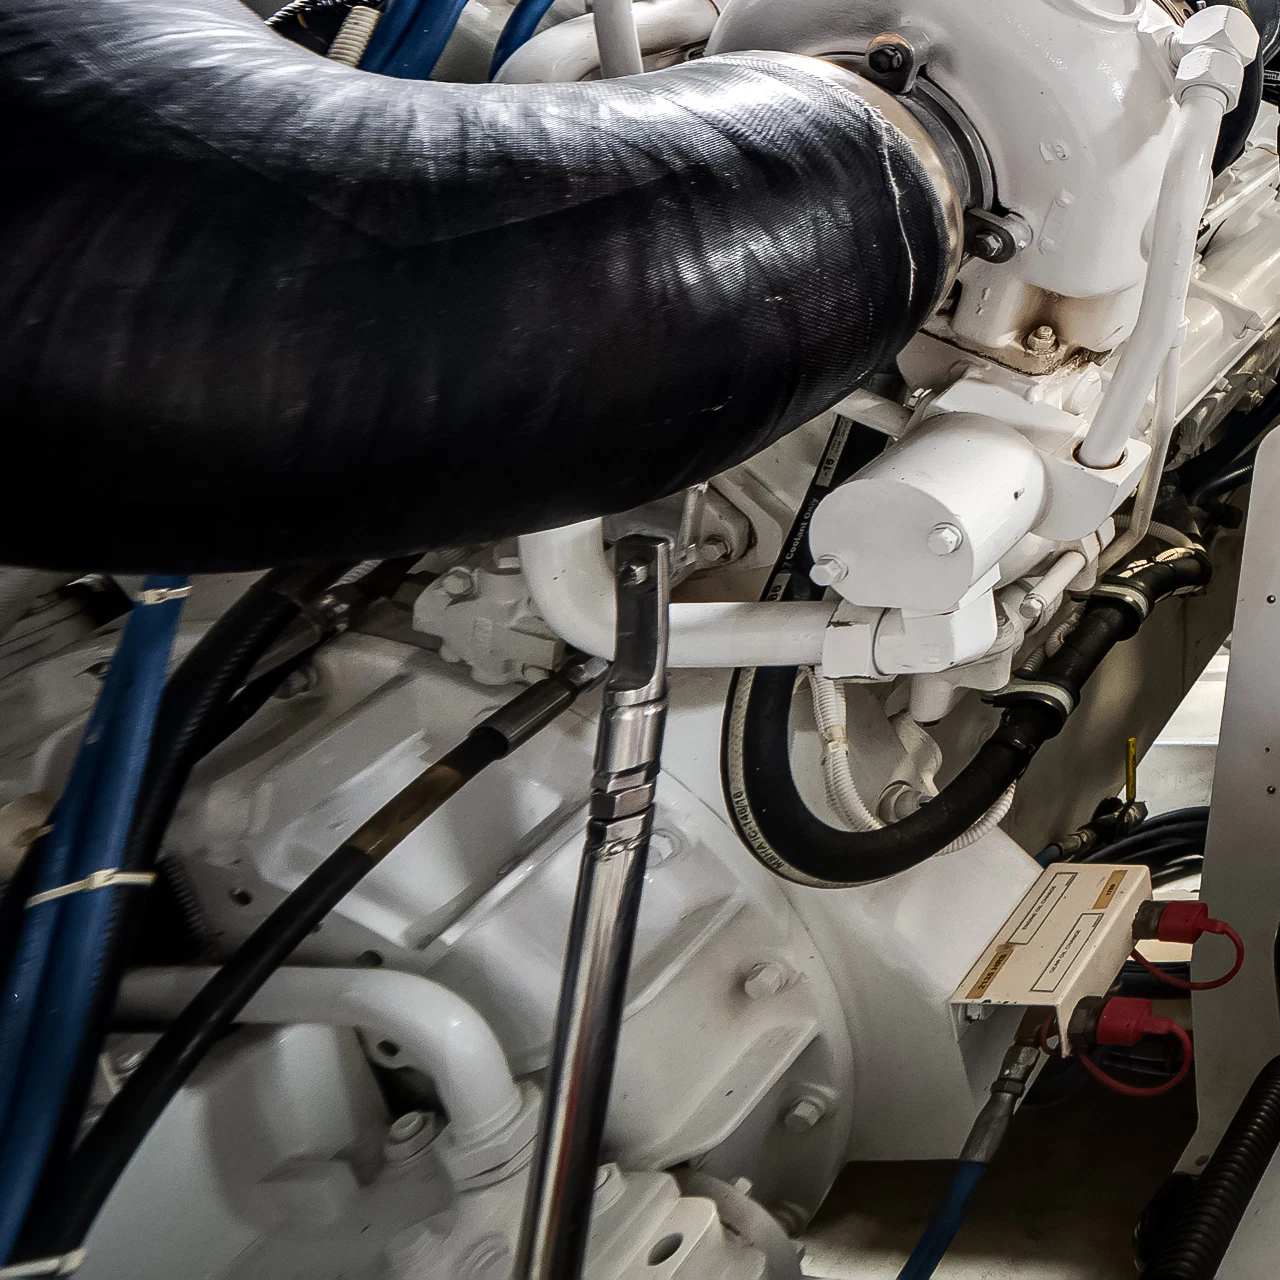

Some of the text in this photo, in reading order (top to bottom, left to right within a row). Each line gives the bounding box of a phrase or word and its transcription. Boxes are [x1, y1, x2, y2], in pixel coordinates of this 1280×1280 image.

[785, 521, 809, 560] Coolant
[804, 497, 819, 520] Only
[1021, 885, 1057, 931] ENGINE OIL CHANGE
[1049, 928, 1082, 974] GEAR OIL CHANGE
